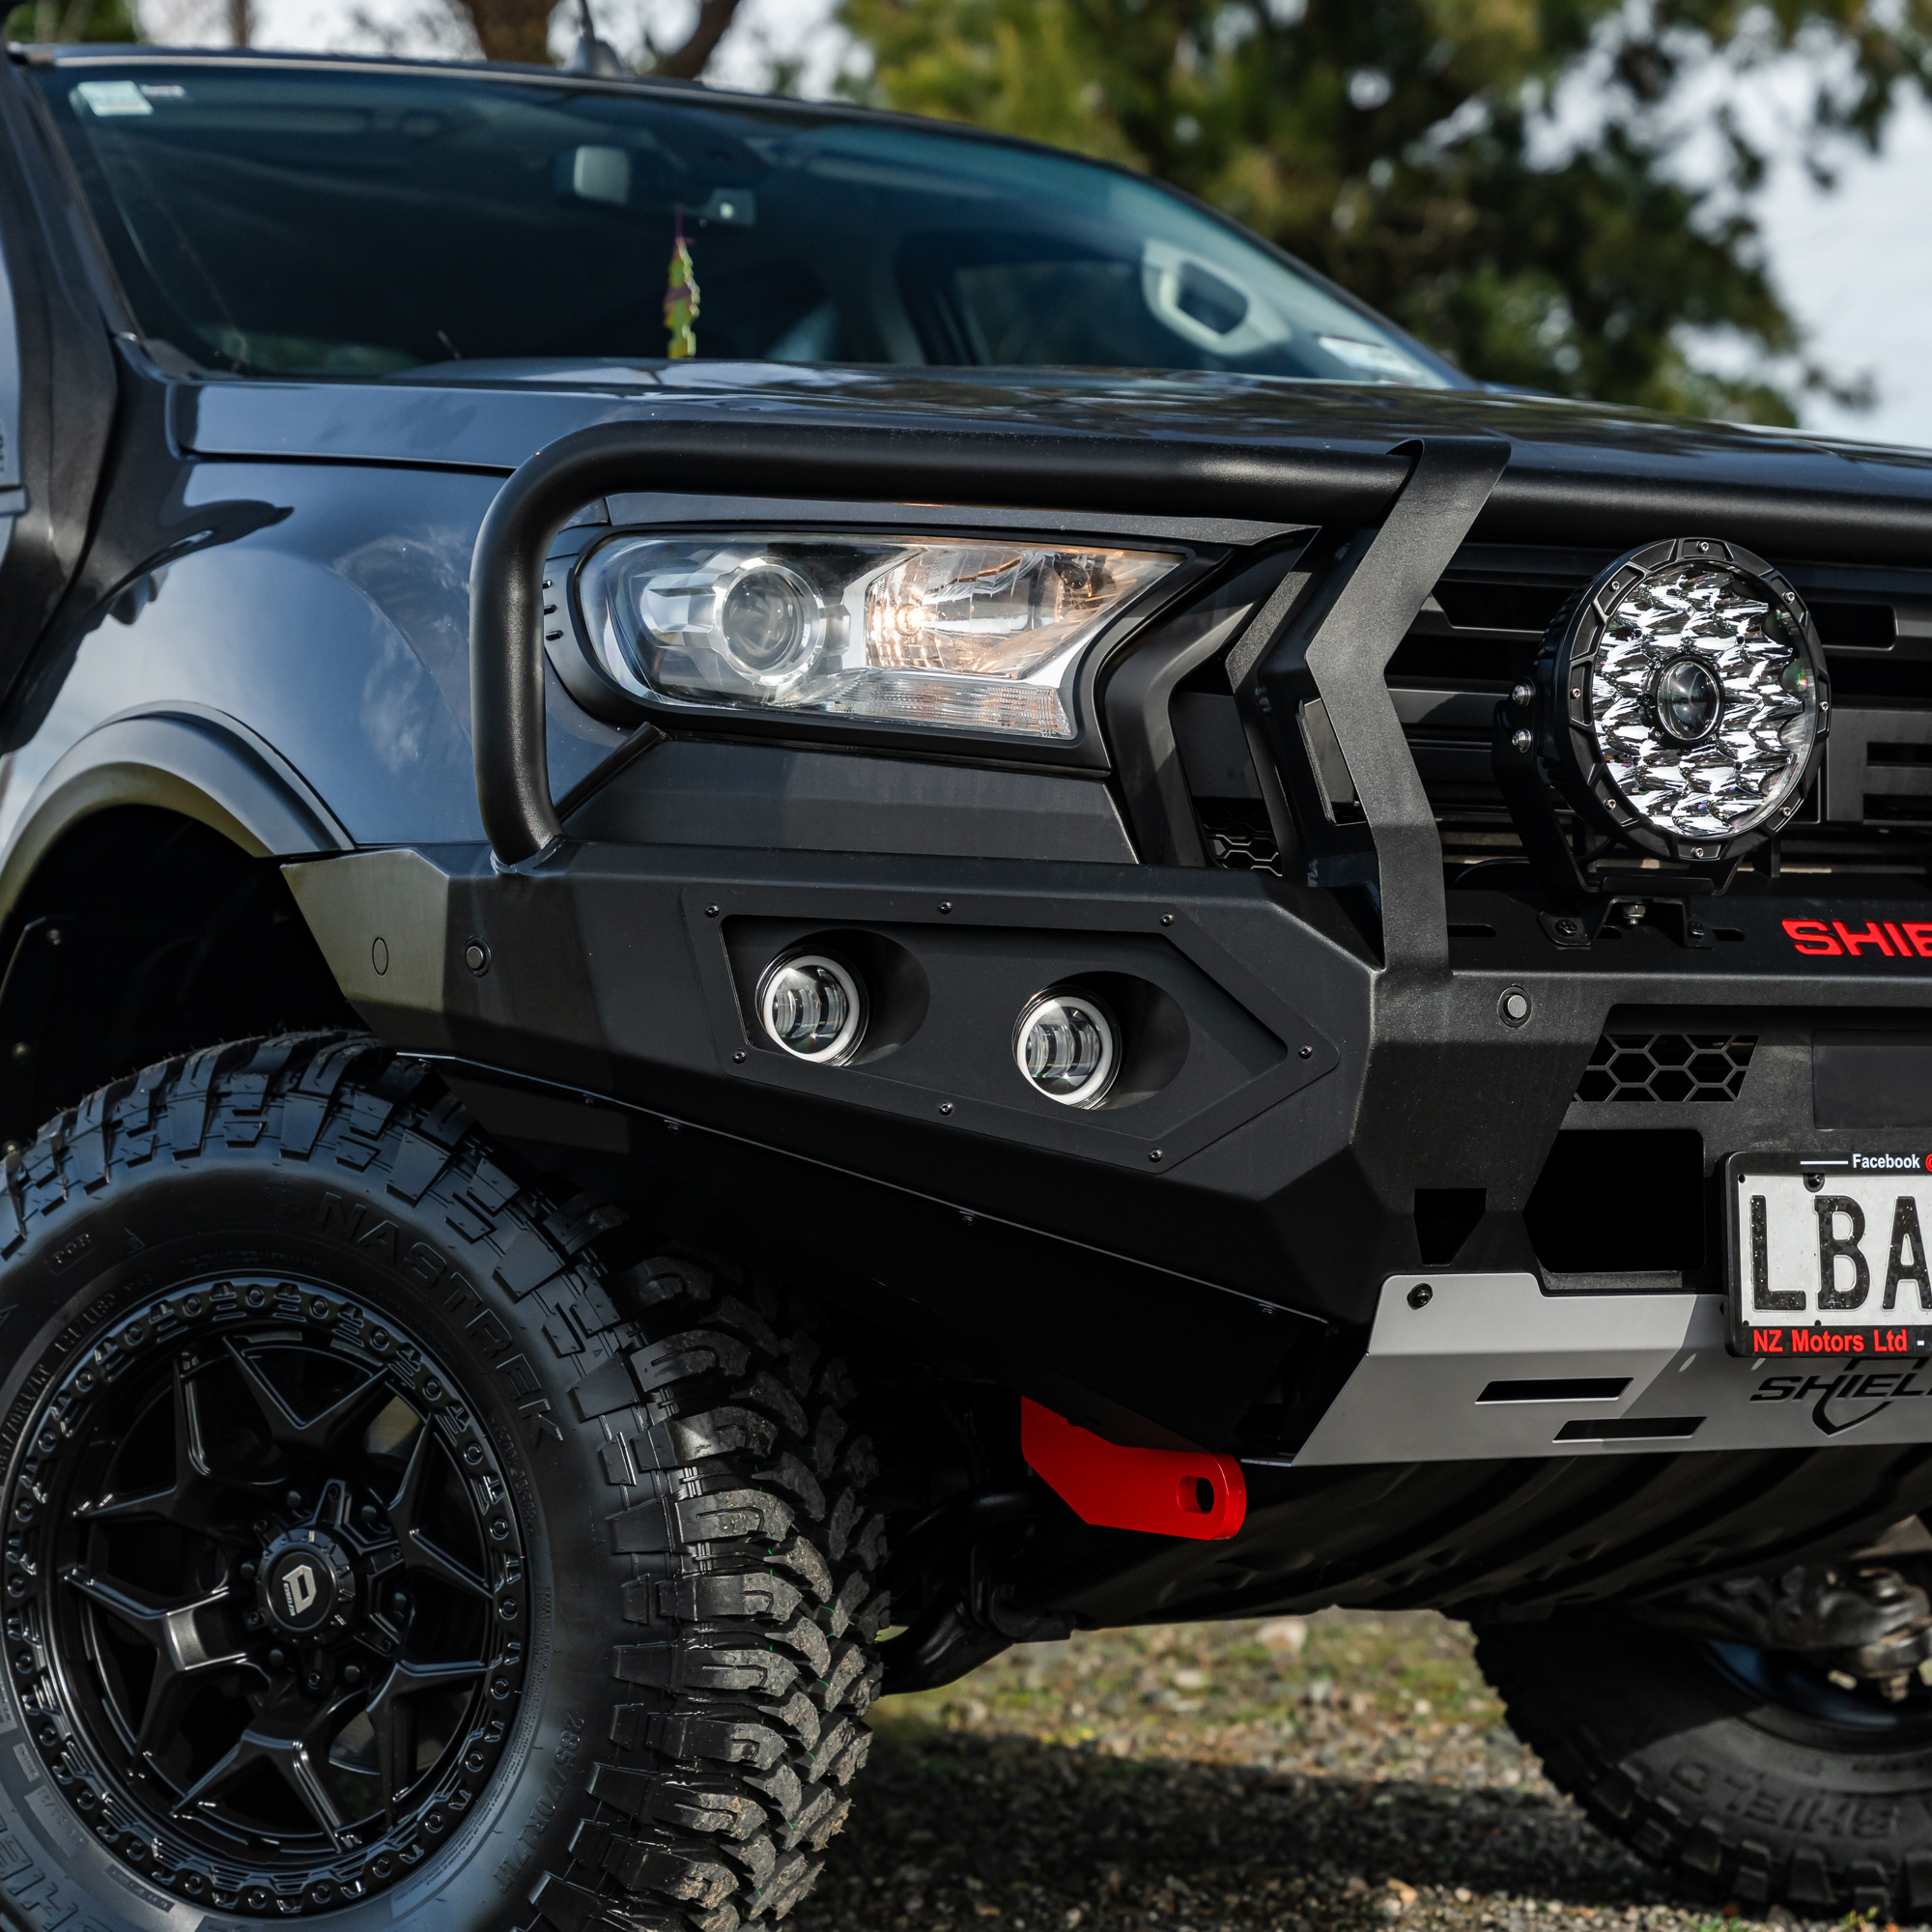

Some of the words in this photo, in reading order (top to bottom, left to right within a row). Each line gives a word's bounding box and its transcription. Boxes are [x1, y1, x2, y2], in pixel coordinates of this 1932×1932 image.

[1781, 919, 1932, 957] SHIE
[1852, 1153, 1920, 1169] Facebook
[1749, 1194, 1932, 1311] LBA
[315, 1191, 564, 1451] NASTREK
[1752, 1329, 1784, 1352] NZ
[1792, 1329, 1865, 1352] Motors
[1873, 1328, 1908, 1352] Ltd
